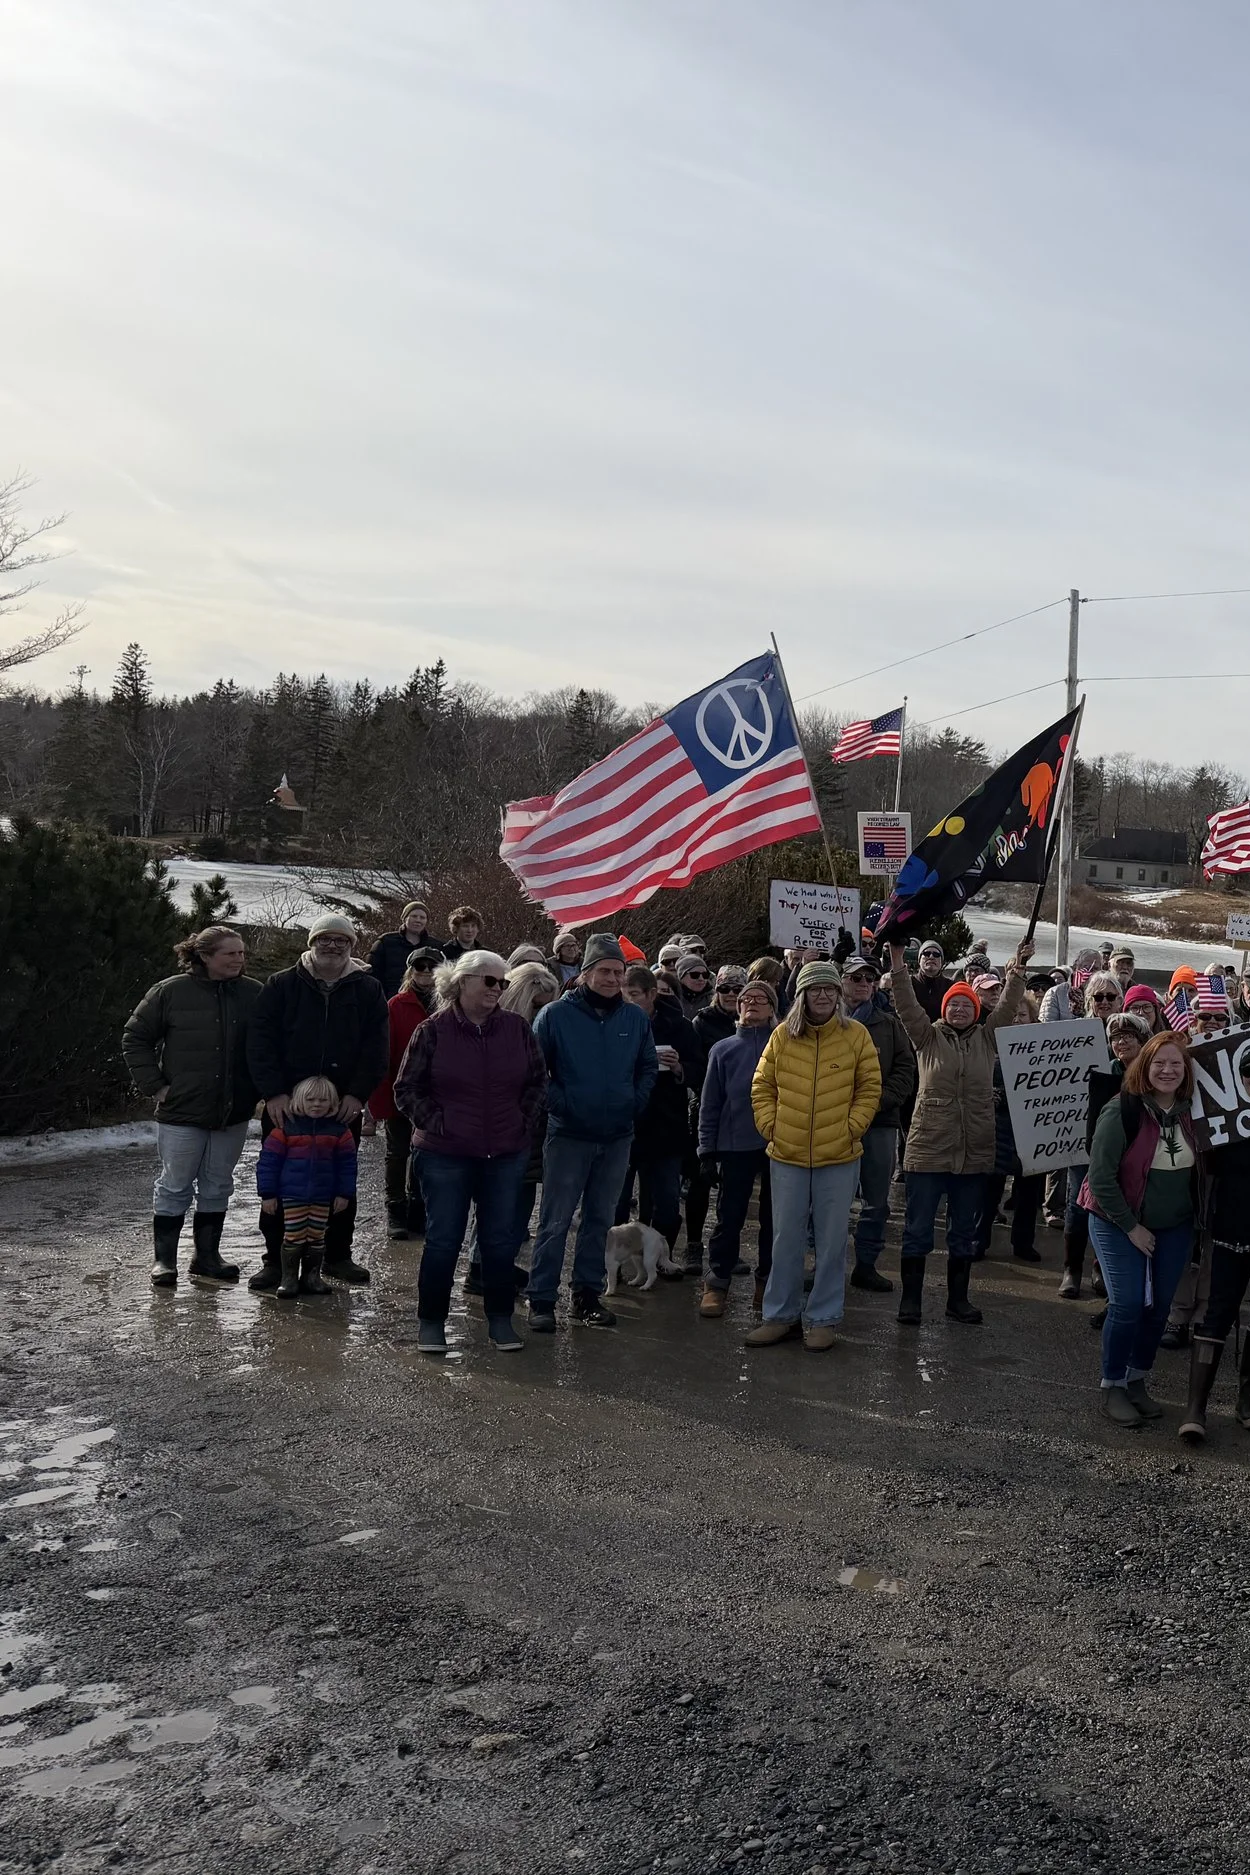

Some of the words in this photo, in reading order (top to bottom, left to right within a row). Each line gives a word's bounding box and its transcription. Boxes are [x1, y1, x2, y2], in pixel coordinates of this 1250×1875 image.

[785, 887, 798, 896] We
[801, 888, 817, 896] had
[778, 899, 800, 915] They
[803, 900, 817, 910] had
[1231, 915, 1243, 924] We
[809, 929, 826, 938] FOR
[1008, 1041, 1037, 1056] THE
[1040, 1035, 1095, 1051] POWER
[1028, 1055, 1045, 1066] OF
[1047, 1052, 1074, 1064] THE
[1013, 1064, 1099, 1091] PEOPLE
[1024, 1094, 1076, 1110] TRUMPS
[1055, 1126, 1073, 1138] IN
